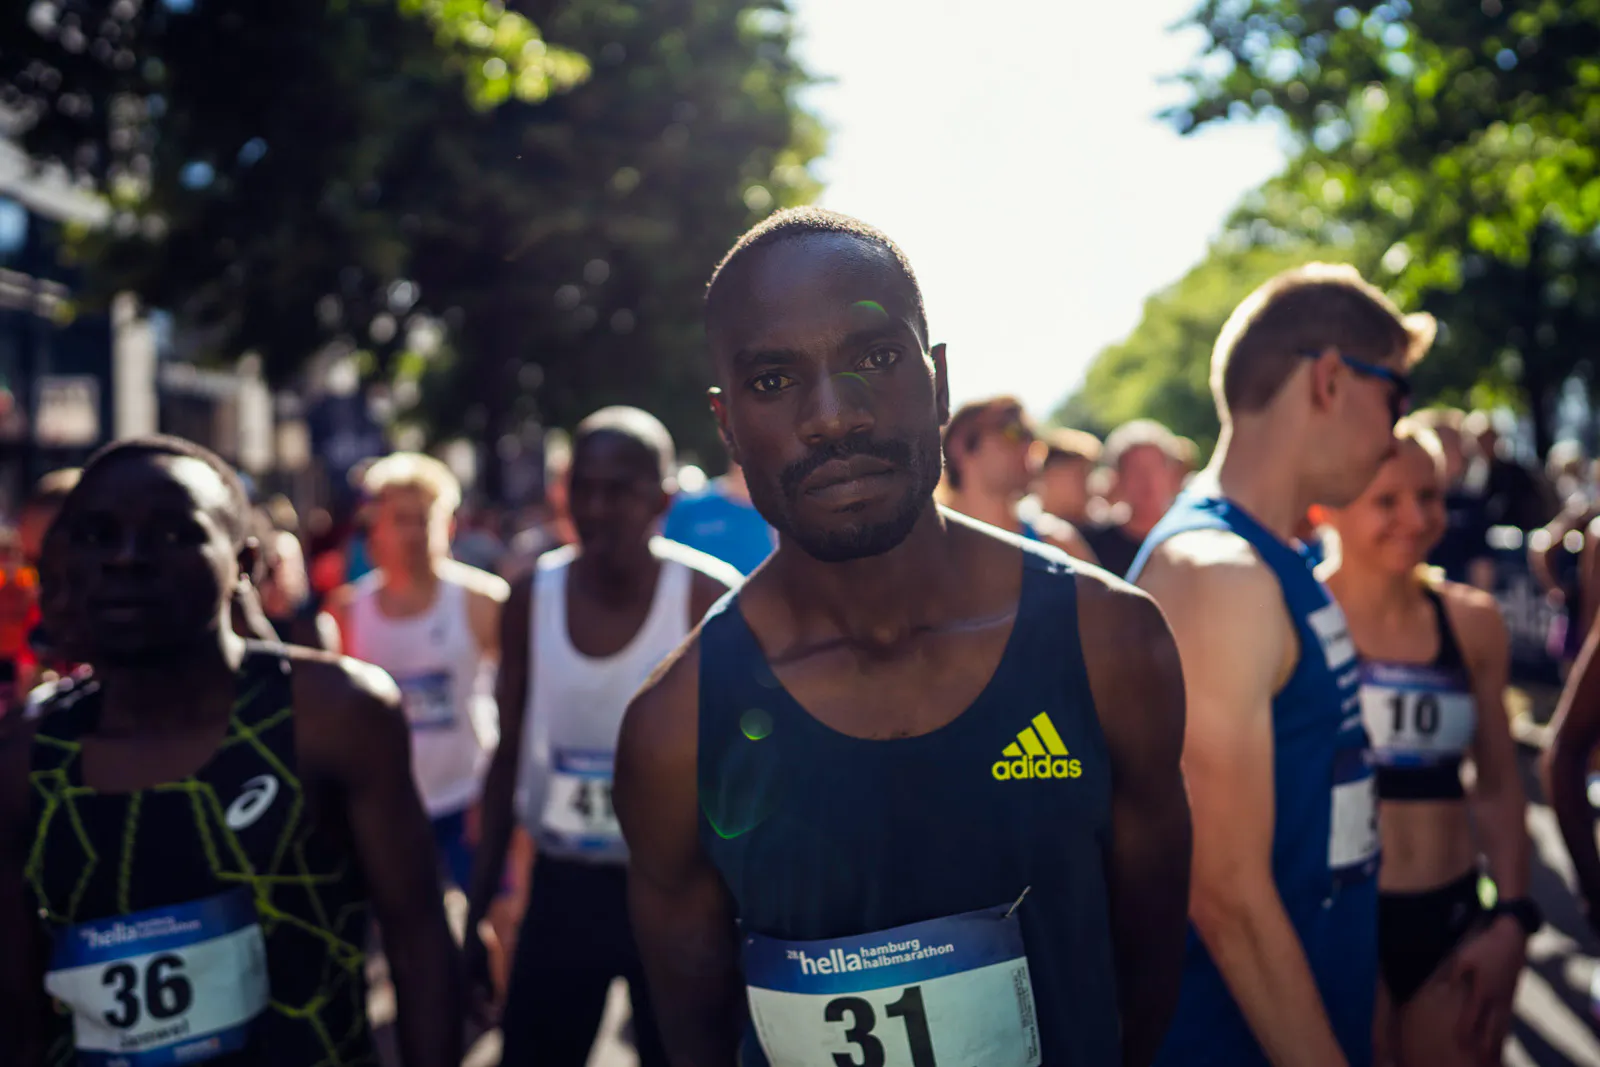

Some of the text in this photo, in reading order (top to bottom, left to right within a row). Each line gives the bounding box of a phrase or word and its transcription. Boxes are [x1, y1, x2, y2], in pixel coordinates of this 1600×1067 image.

[1387, 692, 1440, 735] 10
[992, 754, 1083, 781] adidas
[800, 948, 862, 975] hella
[860, 939, 920, 957] hamburg
[862, 943, 954, 969] halbmarathon
[102, 953, 193, 1029] 36
[824, 985, 938, 1067] 31
